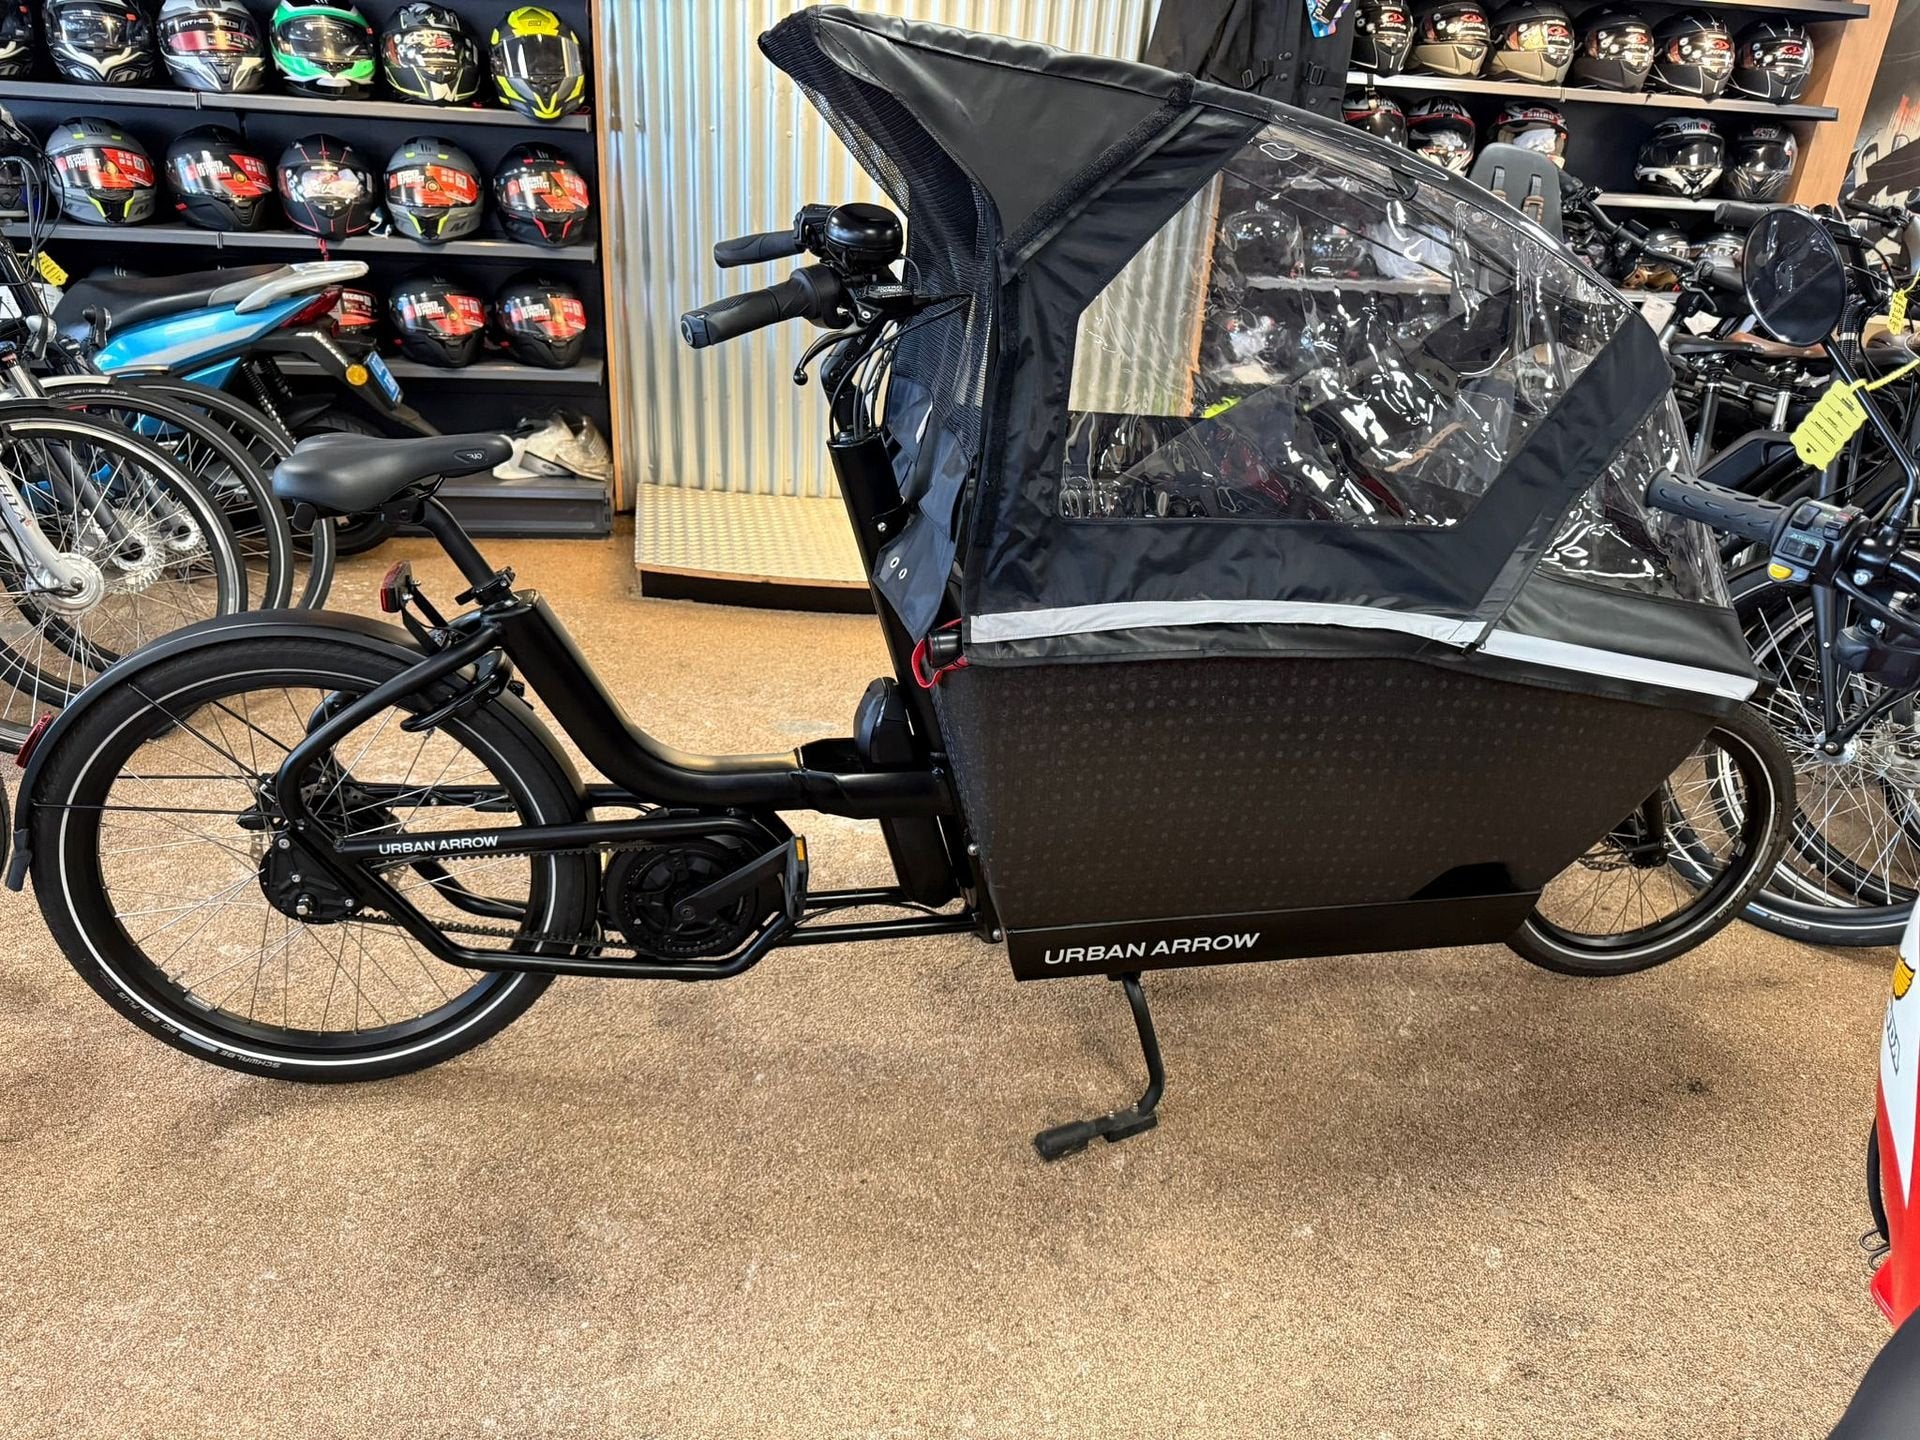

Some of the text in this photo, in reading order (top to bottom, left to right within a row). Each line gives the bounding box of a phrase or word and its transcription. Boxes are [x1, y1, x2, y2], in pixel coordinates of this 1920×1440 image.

[379, 835, 499, 854] URBAN ARROW
[1044, 932, 1261, 965] URBAN ARROW
[117, 992, 281, 1068] SCHWALBE BIG BEN PLUS
